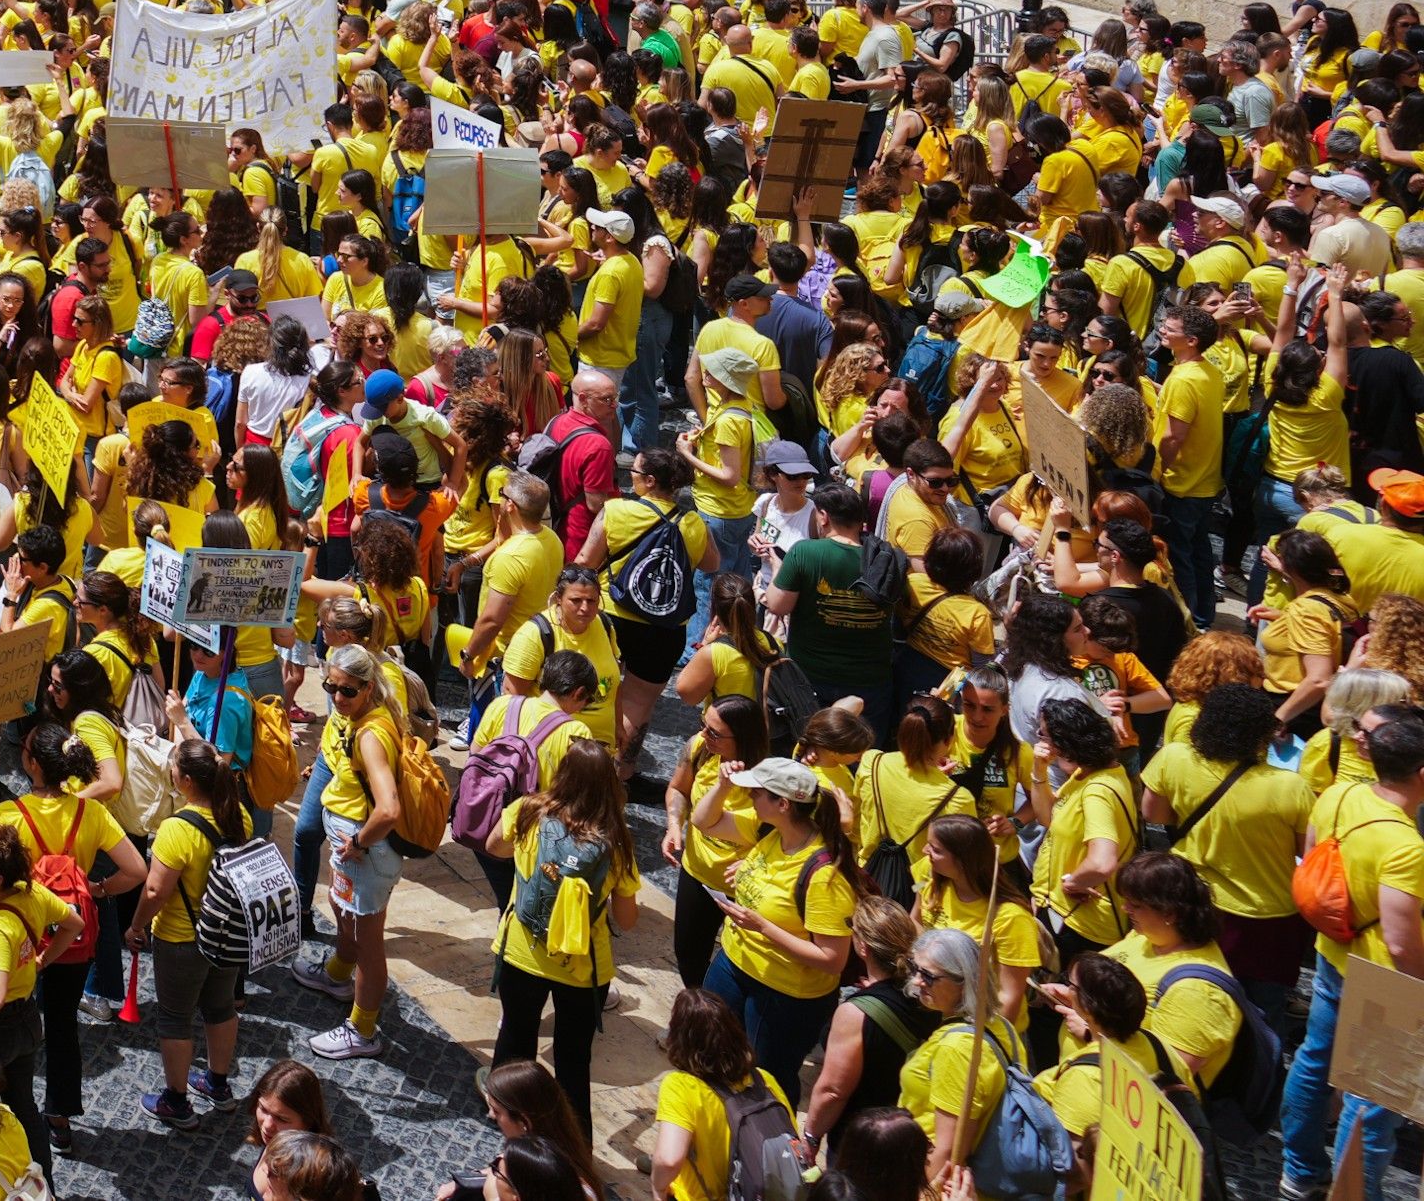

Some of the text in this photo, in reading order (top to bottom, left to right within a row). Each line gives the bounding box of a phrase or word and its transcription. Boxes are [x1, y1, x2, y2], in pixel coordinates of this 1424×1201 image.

[454, 116, 495, 149] RECURSOS
[990, 422, 1011, 436] SOS
[198, 557, 284, 569] TINDREM 70 ANYS
[214, 576, 265, 586] TREBALLANT
[289, 566, 302, 611] PAE
[1086, 667, 1106, 682] JO
[984, 775, 1005, 783] AGA
[245, 859, 260, 872] PROU
[260, 872, 288, 894] SENSE
[249, 887, 296, 938] PAE
[262, 925, 289, 943] NO HI HA
[254, 933, 297, 960] INCLUSIVA
[1112, 1058, 1144, 1128] NO
